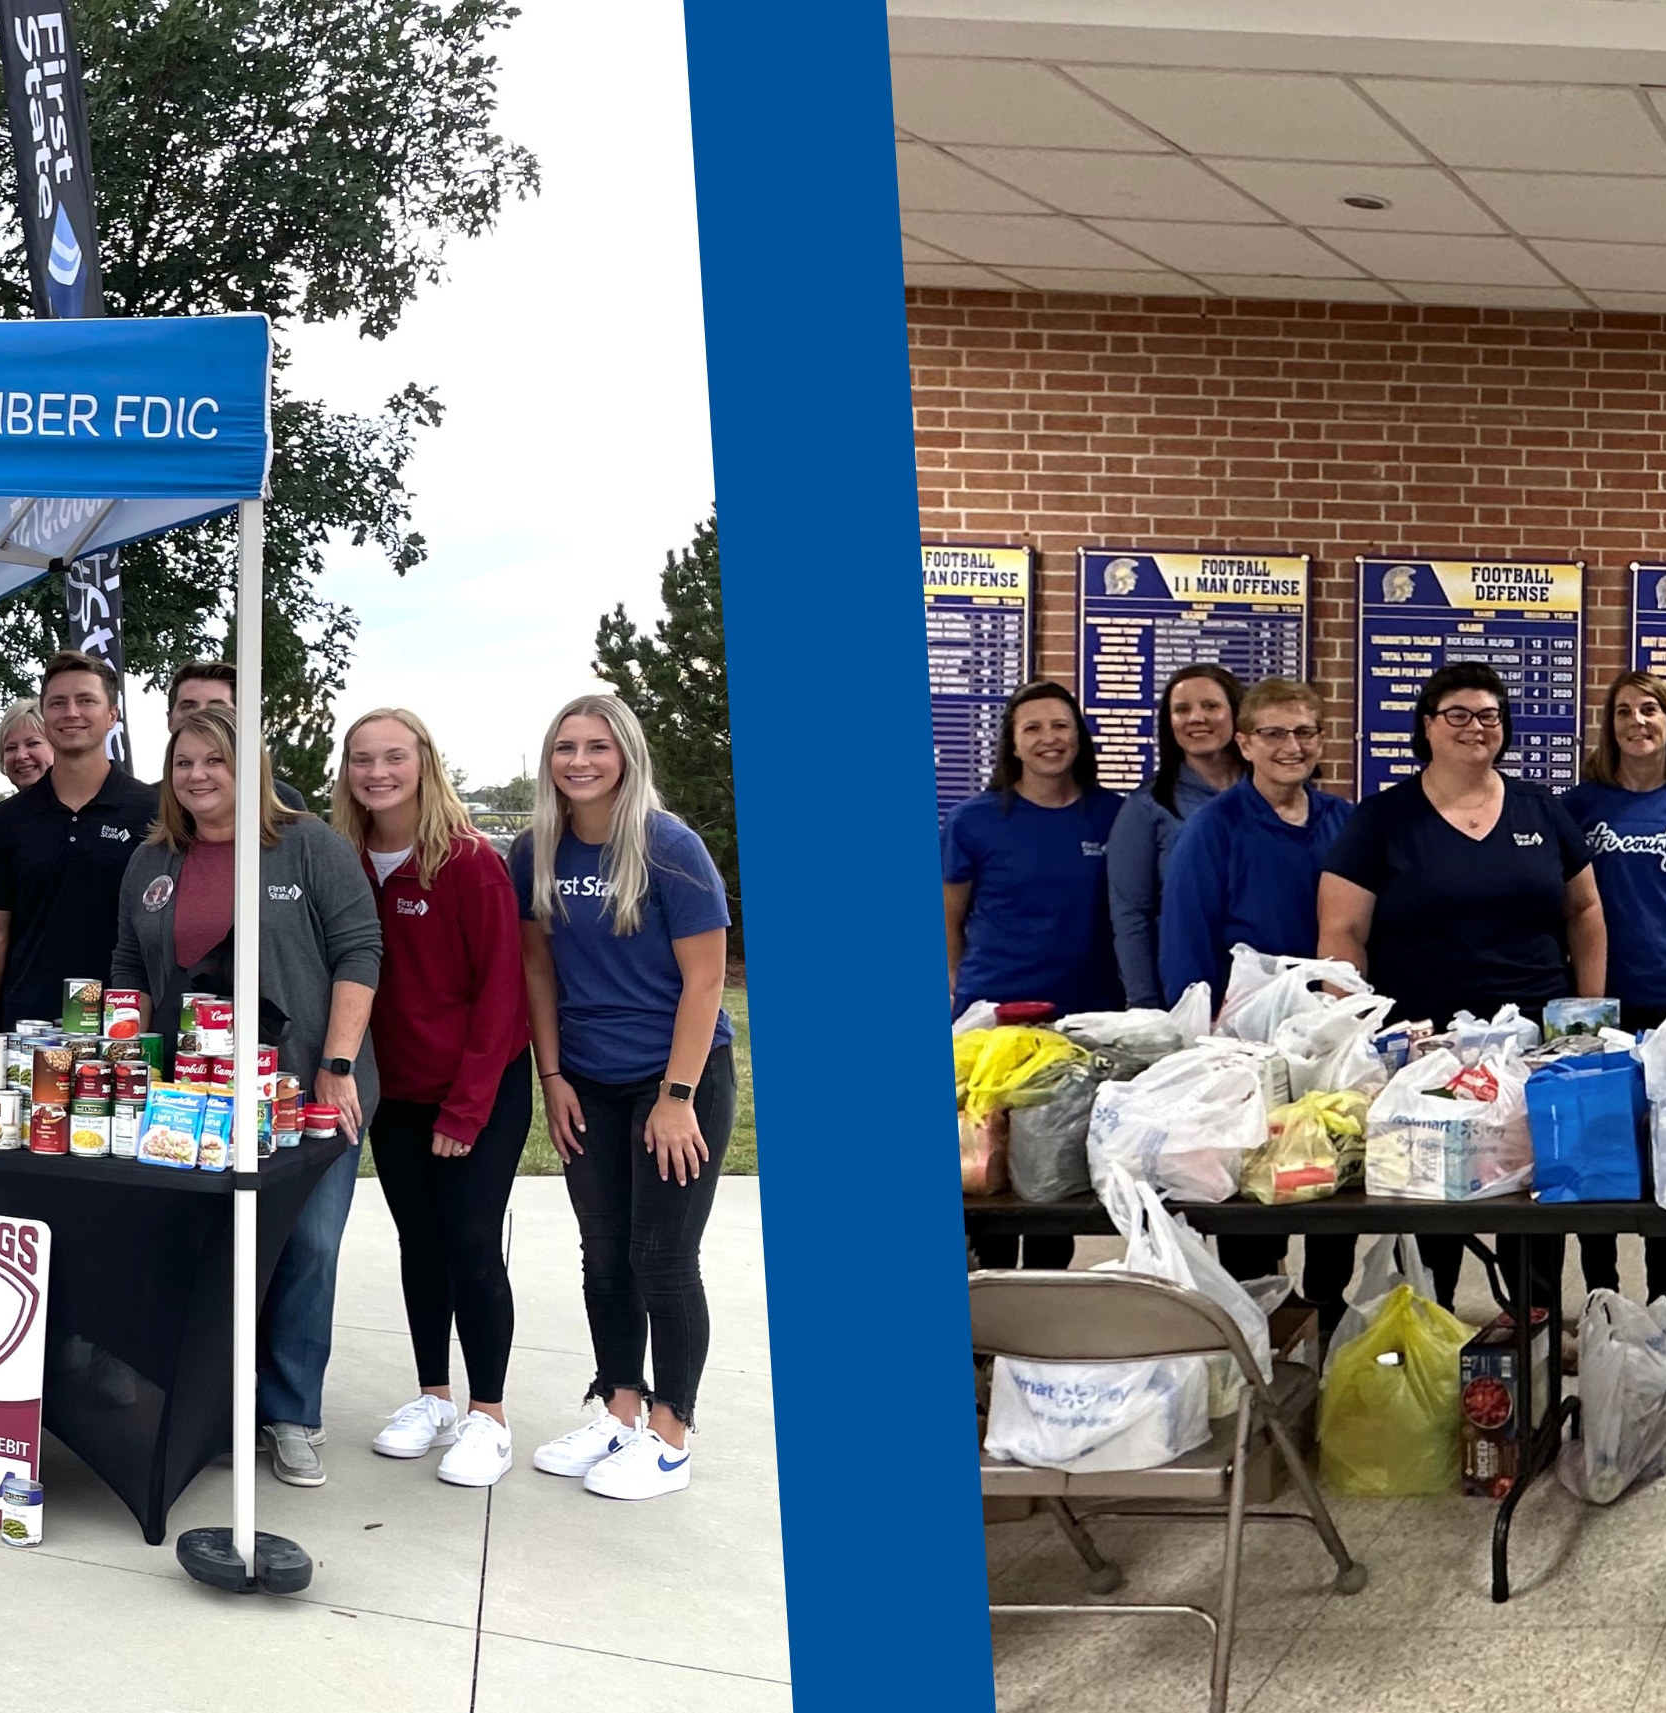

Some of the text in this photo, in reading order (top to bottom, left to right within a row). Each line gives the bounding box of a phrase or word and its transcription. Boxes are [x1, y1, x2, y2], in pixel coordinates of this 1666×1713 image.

[37, 12, 74, 183] First
[13, 15, 54, 221] State
[114, 395, 220, 441] FDIC
[925, 551, 995, 569] FOOTBALL
[1201, 559, 1271, 578] FOOTBALL
[951, 571, 1020, 588] OFFENSE
[1471, 566, 1554, 585] FOOTBALL
[1196, 578, 1228, 594] MAN
[1232, 579, 1300, 596] OFFENSE
[1475, 585, 1550, 603] DEFENSE
[269, 885, 287, 893] First
[269, 892, 290, 901] State
[397, 898, 414, 908] First
[397, 906, 416, 916] State
[152, 1112, 193, 1125] Light Tuna
[1476, 1440, 1489, 1478] DICED
